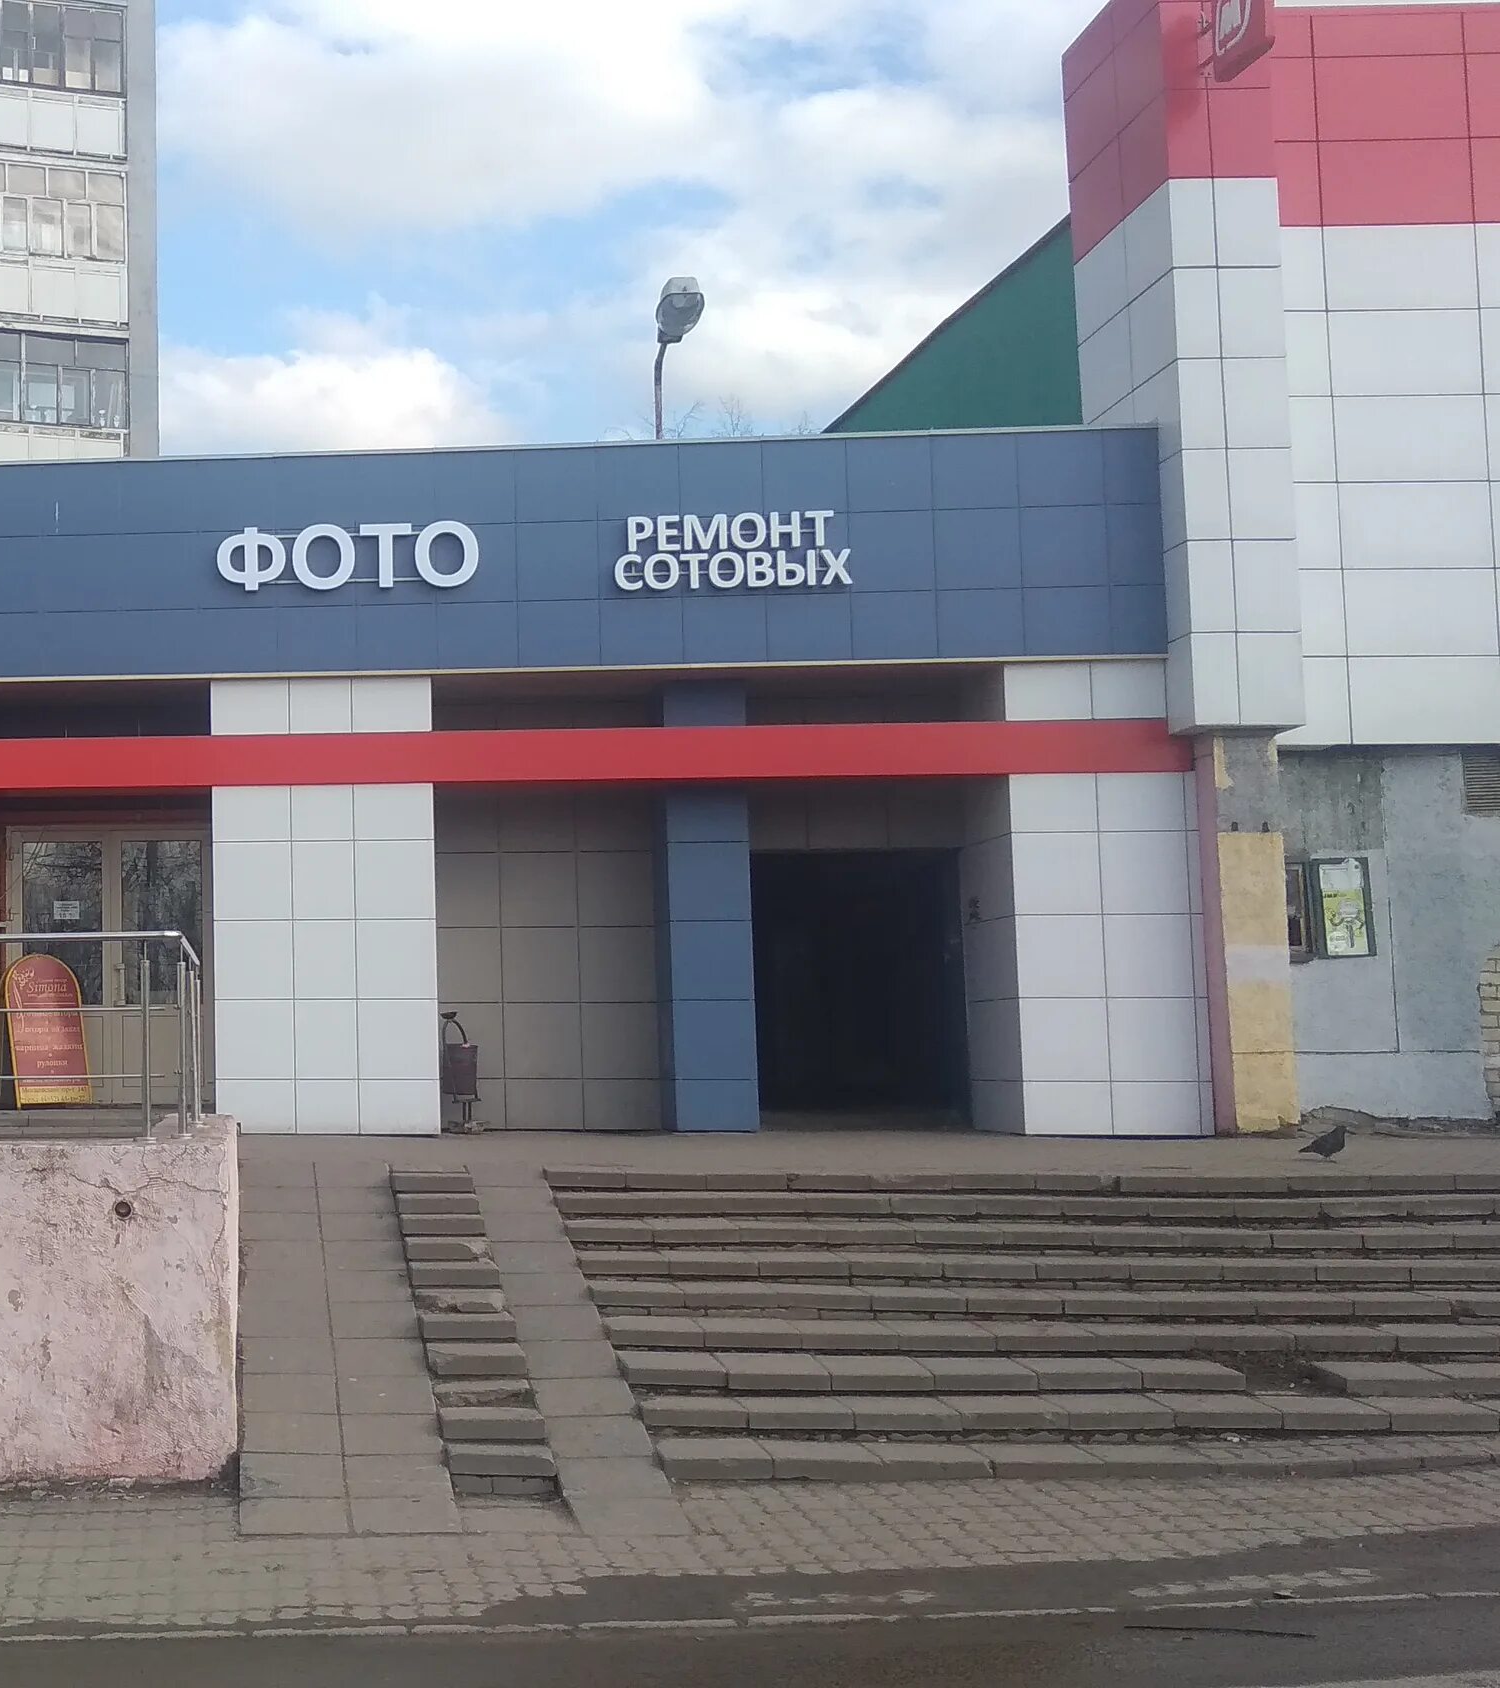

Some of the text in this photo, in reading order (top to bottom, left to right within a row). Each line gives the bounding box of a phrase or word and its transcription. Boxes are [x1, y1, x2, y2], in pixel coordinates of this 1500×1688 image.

[626, 510, 834, 552] РЕМОНТ
[215, 520, 480, 592] ФОТО
[612, 548, 852, 591] СОТОВЫХ
